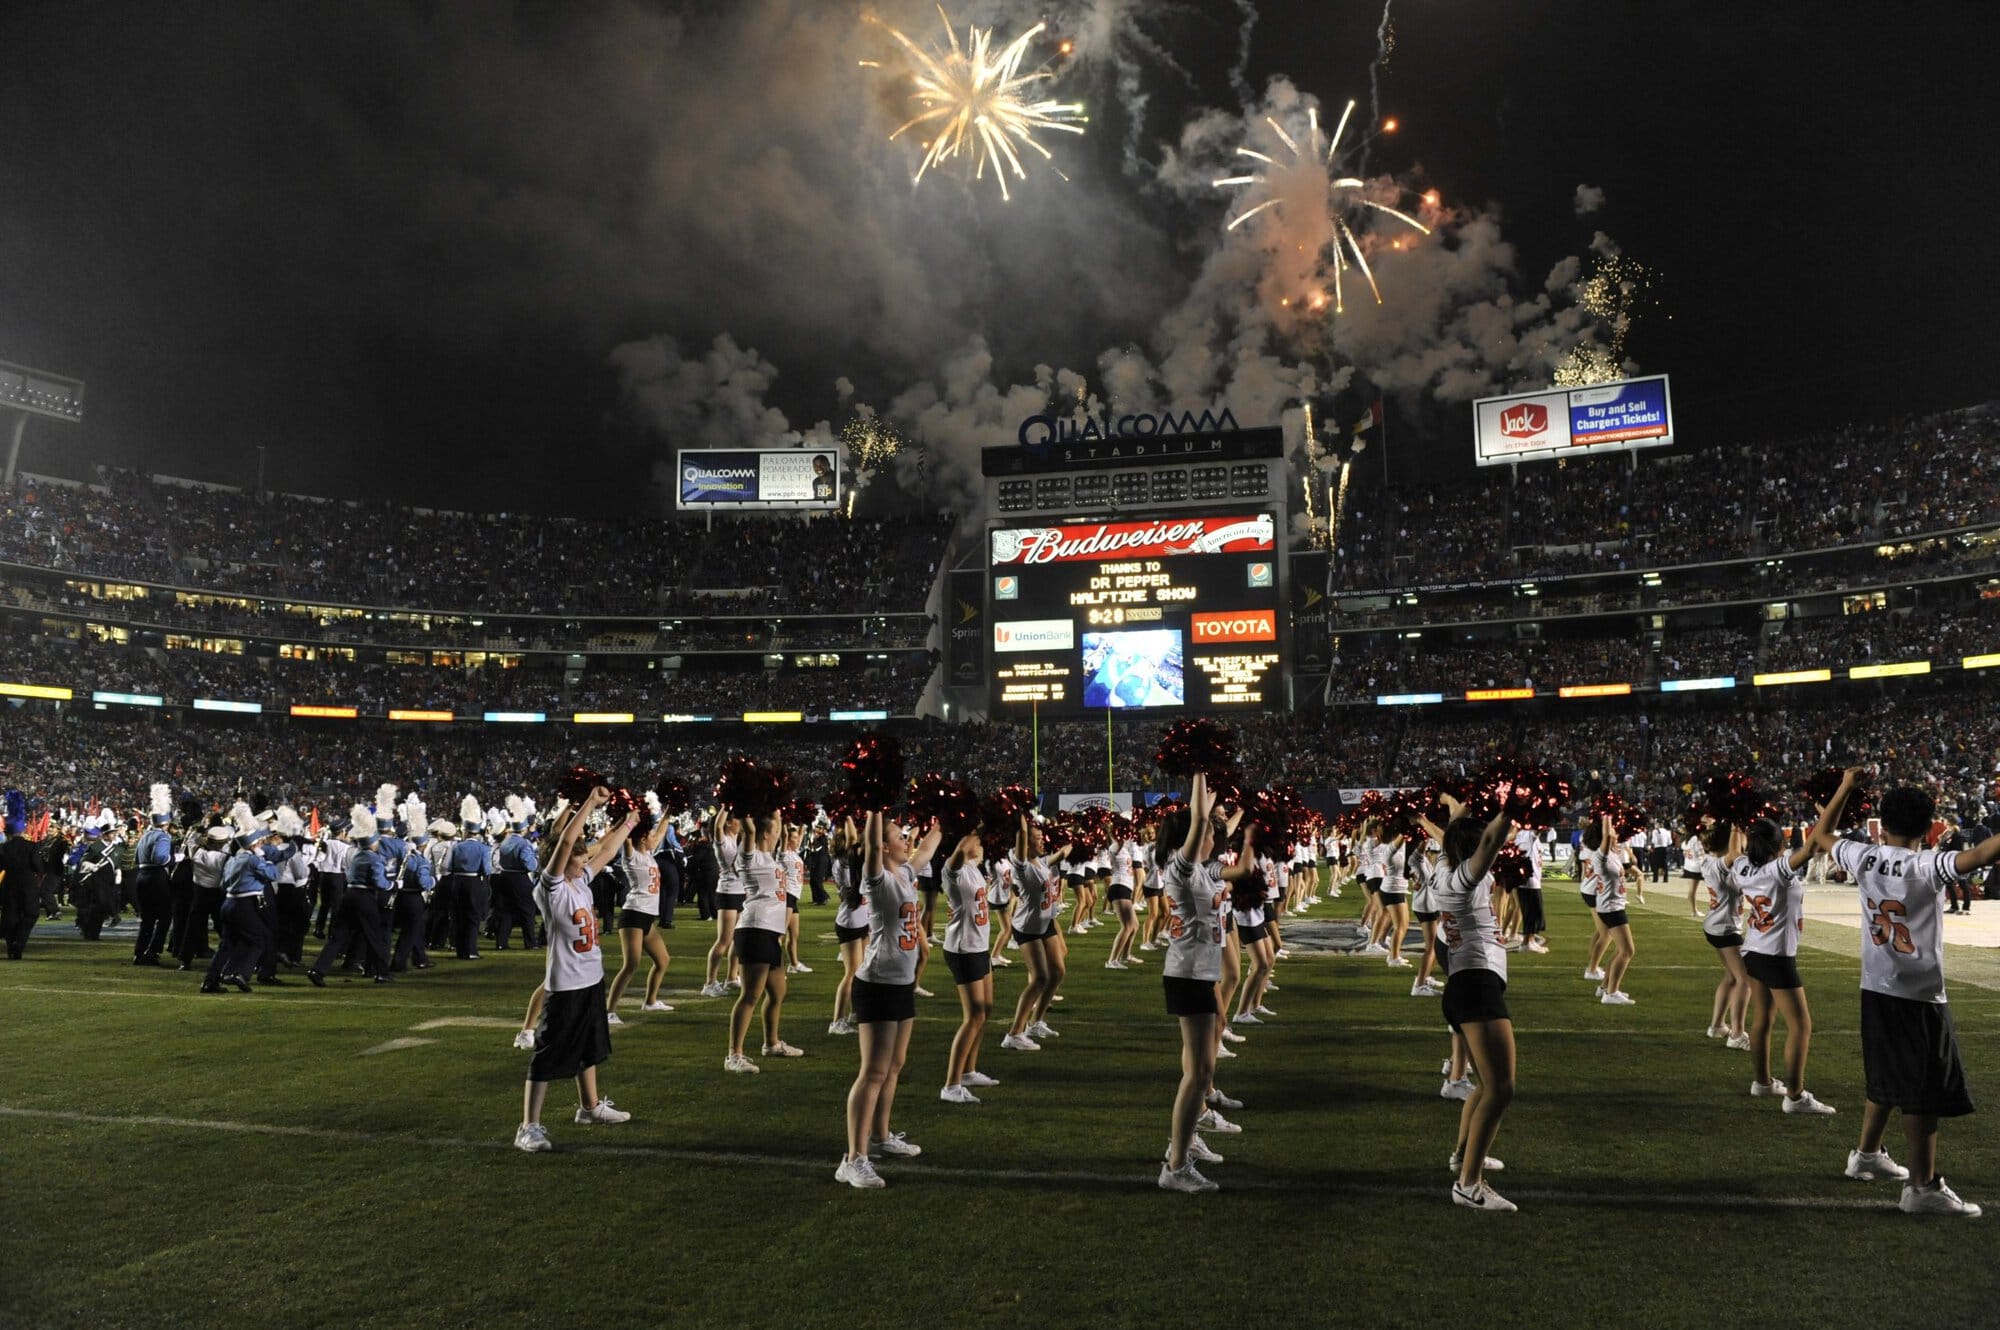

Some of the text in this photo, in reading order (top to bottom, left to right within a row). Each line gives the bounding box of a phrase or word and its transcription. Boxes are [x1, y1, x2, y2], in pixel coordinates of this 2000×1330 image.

[1588, 400, 1647, 418] Buy and Sell
[1502, 407, 1546, 435] Jack
[1576, 411, 1660, 431] Chargers Tickets!
[1018, 407, 1240, 456] QUALCOMM
[1065, 440, 1222, 460] STADIUM
[763, 457, 812, 465] PALOMAR
[763, 465, 812, 473] POMERADO
[685, 467, 756, 483] QUALCOMM
[1016, 520, 1204, 565] Budweiser
[1099, 561, 1161, 574] THANKS TO
[1090, 573, 1171, 590] DR PEPPER
[1070, 586, 1197, 605] HALFTIME SHOW
[1015, 631, 1072, 641] UnionBank
[1196, 619, 1271, 636] TOYOTA
[1076, 799, 1115, 810] PACIFIC LIF
[1864, 855, 1902, 877] BGA
